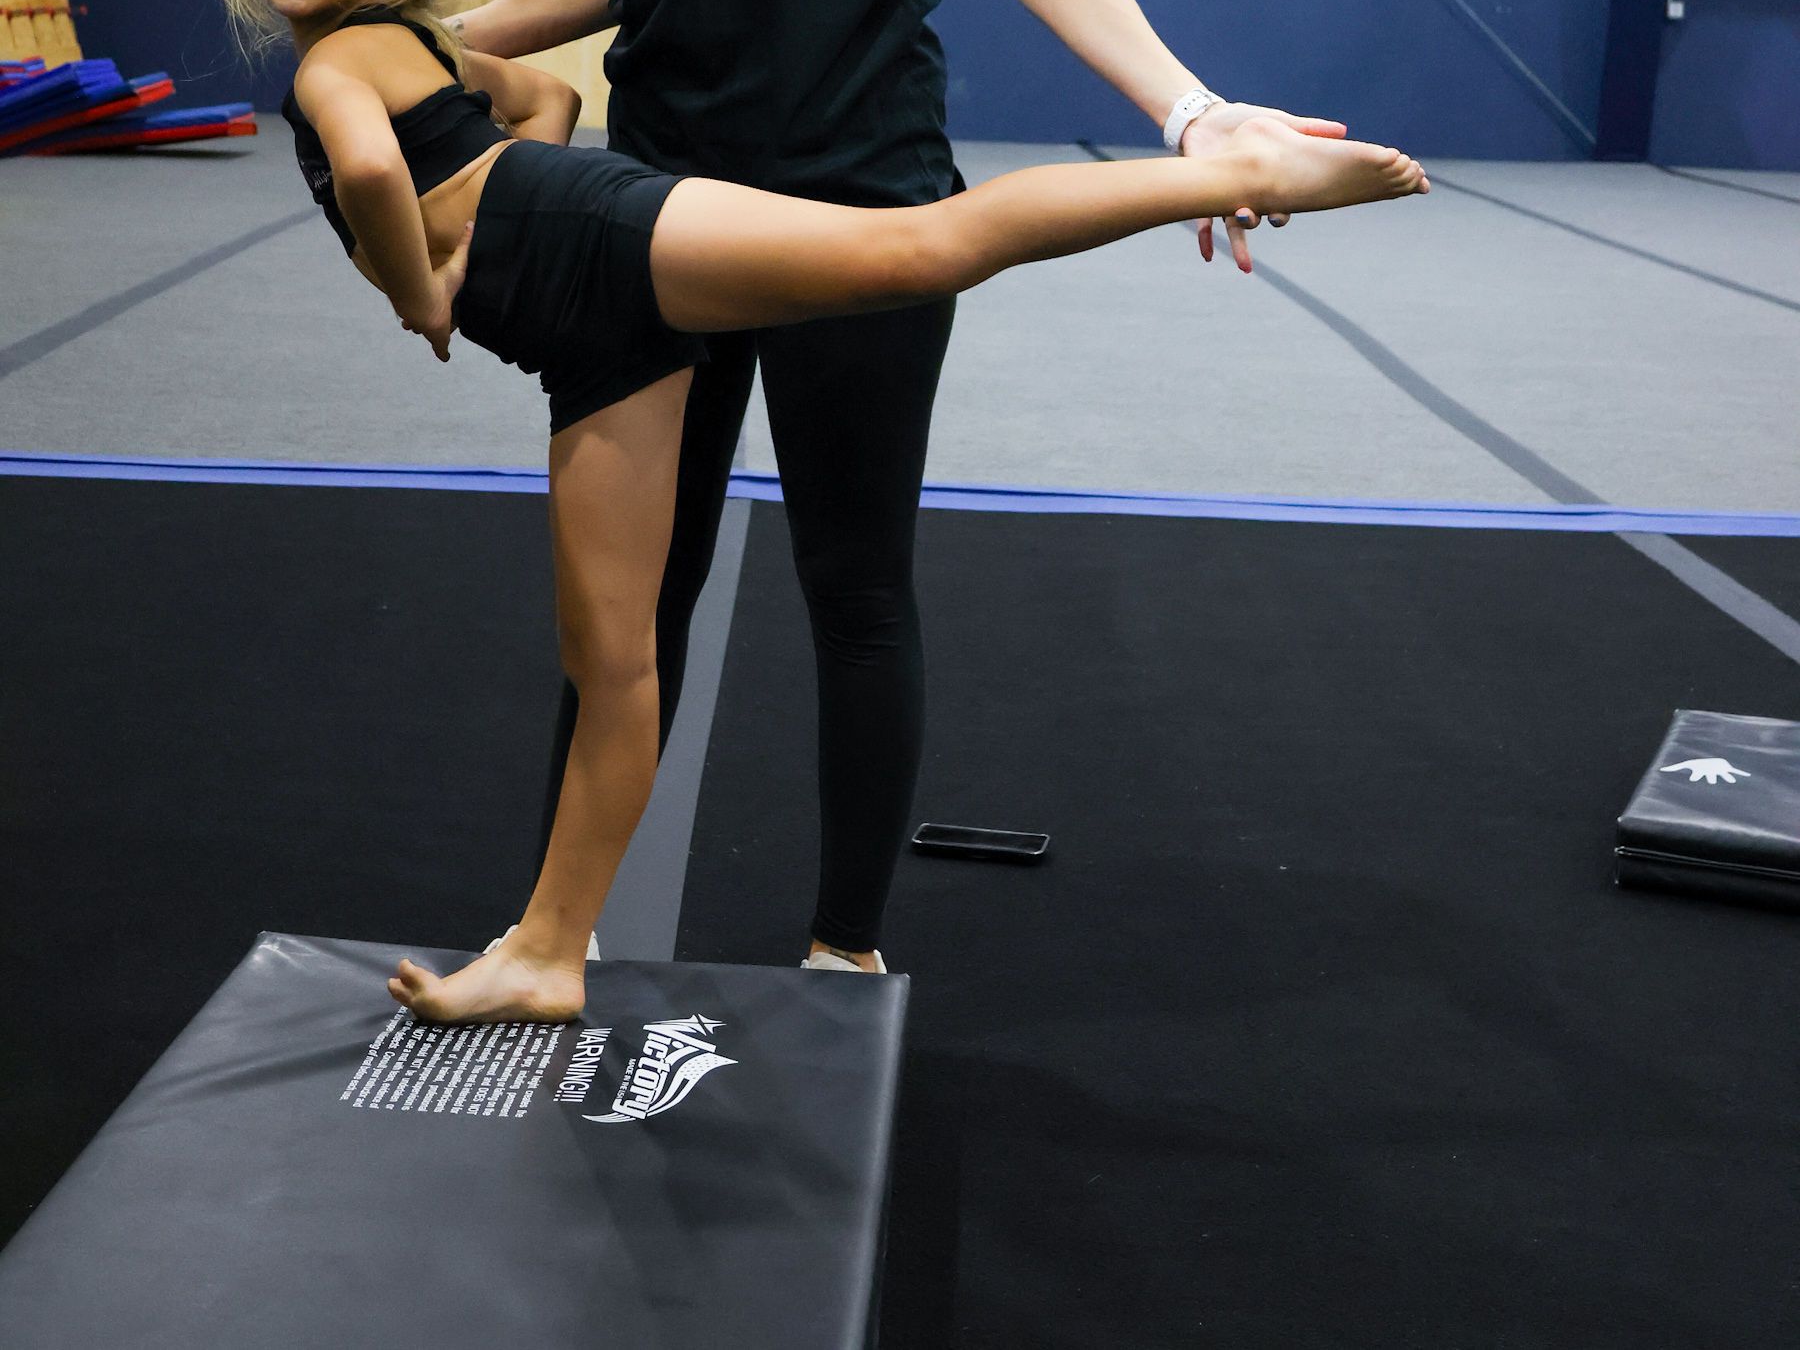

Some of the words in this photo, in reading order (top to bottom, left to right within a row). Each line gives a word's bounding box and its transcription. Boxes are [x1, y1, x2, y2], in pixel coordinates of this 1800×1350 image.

[553, 1028, 613, 1103] WARNING!!!
[611, 1015, 717, 1120] Victory
[624, 1058, 637, 1076] MADE
